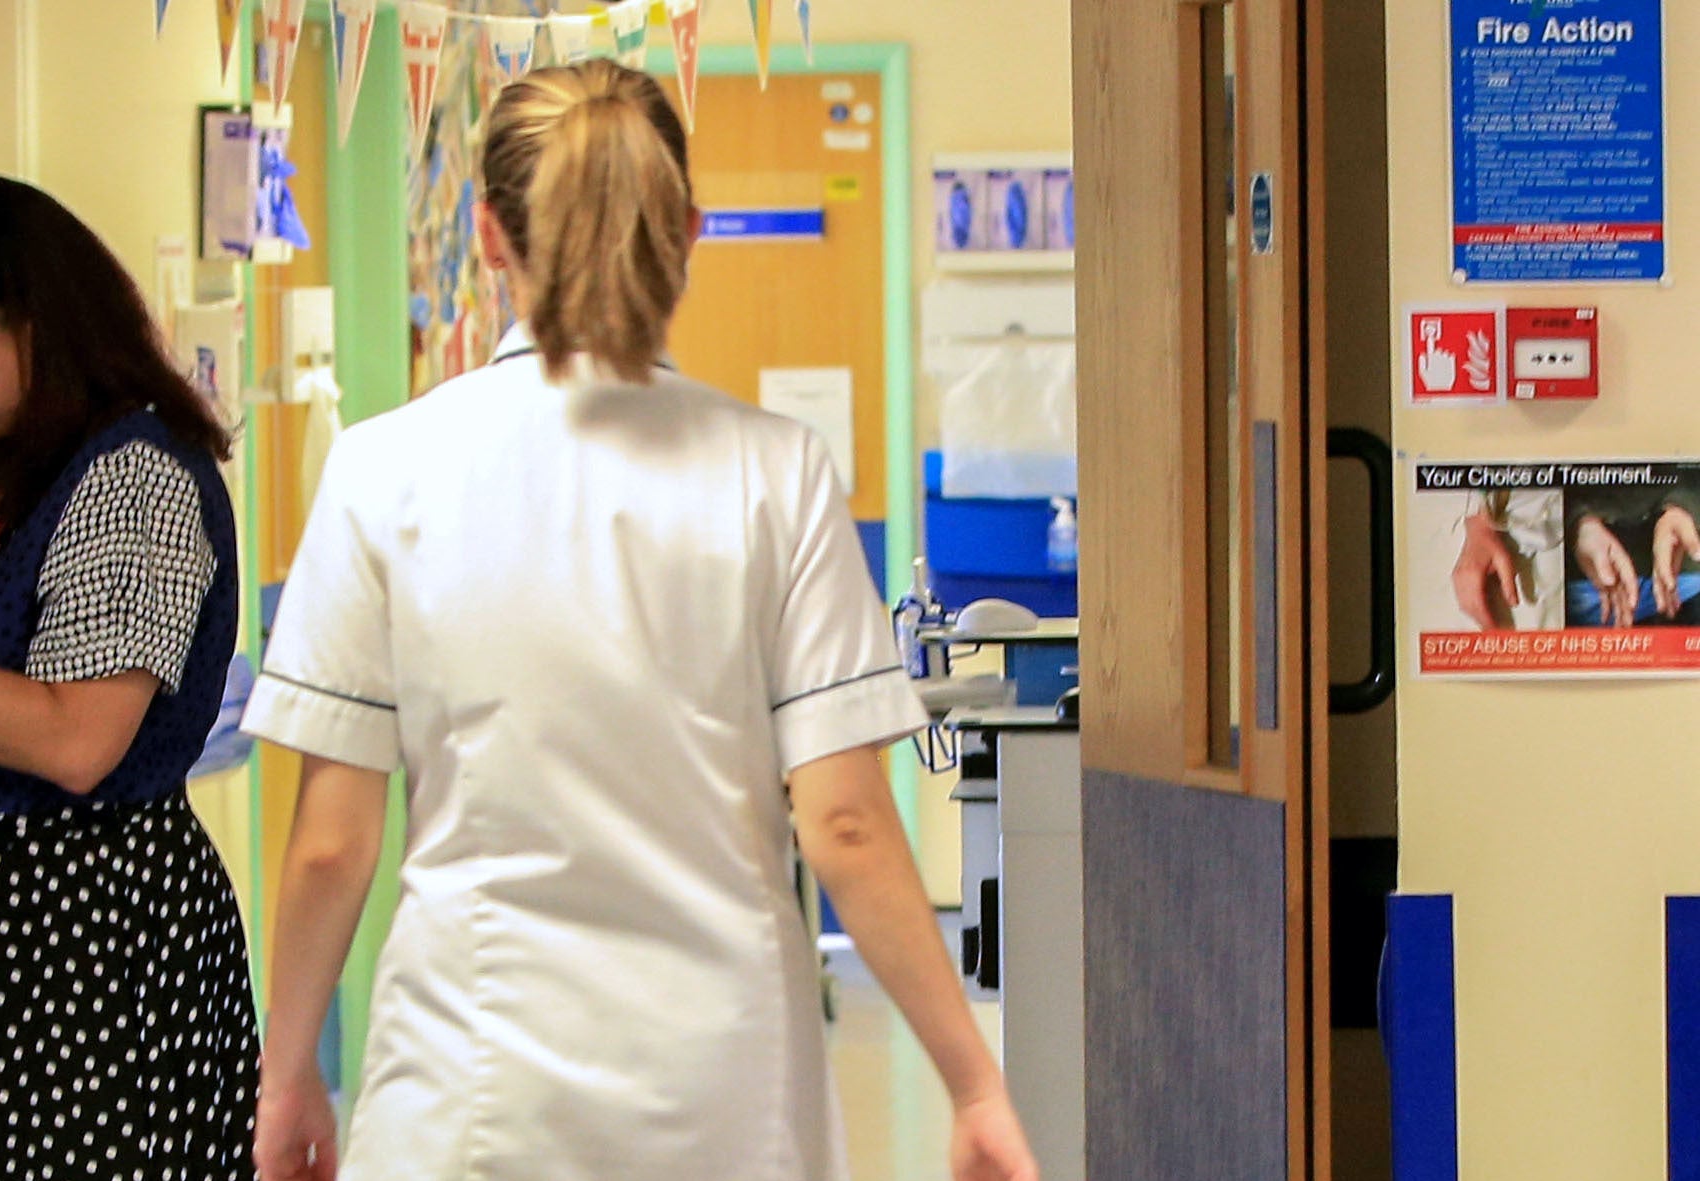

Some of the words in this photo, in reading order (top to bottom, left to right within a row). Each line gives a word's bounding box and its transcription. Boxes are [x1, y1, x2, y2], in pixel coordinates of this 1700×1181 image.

[1477, 16, 1531, 44] Fire
[1541, 15, 1634, 43] Action
[1421, 466, 1464, 487] Your
[1468, 465, 1533, 487] Choice
[1536, 464, 1555, 486] of
[1424, 636, 1470, 655] STOP
[1472, 635, 1530, 655] ABUSE
[1533, 636, 1557, 654] OF
[1560, 635, 1598, 653] NHS
[1600, 634, 1652, 653] STAFF
